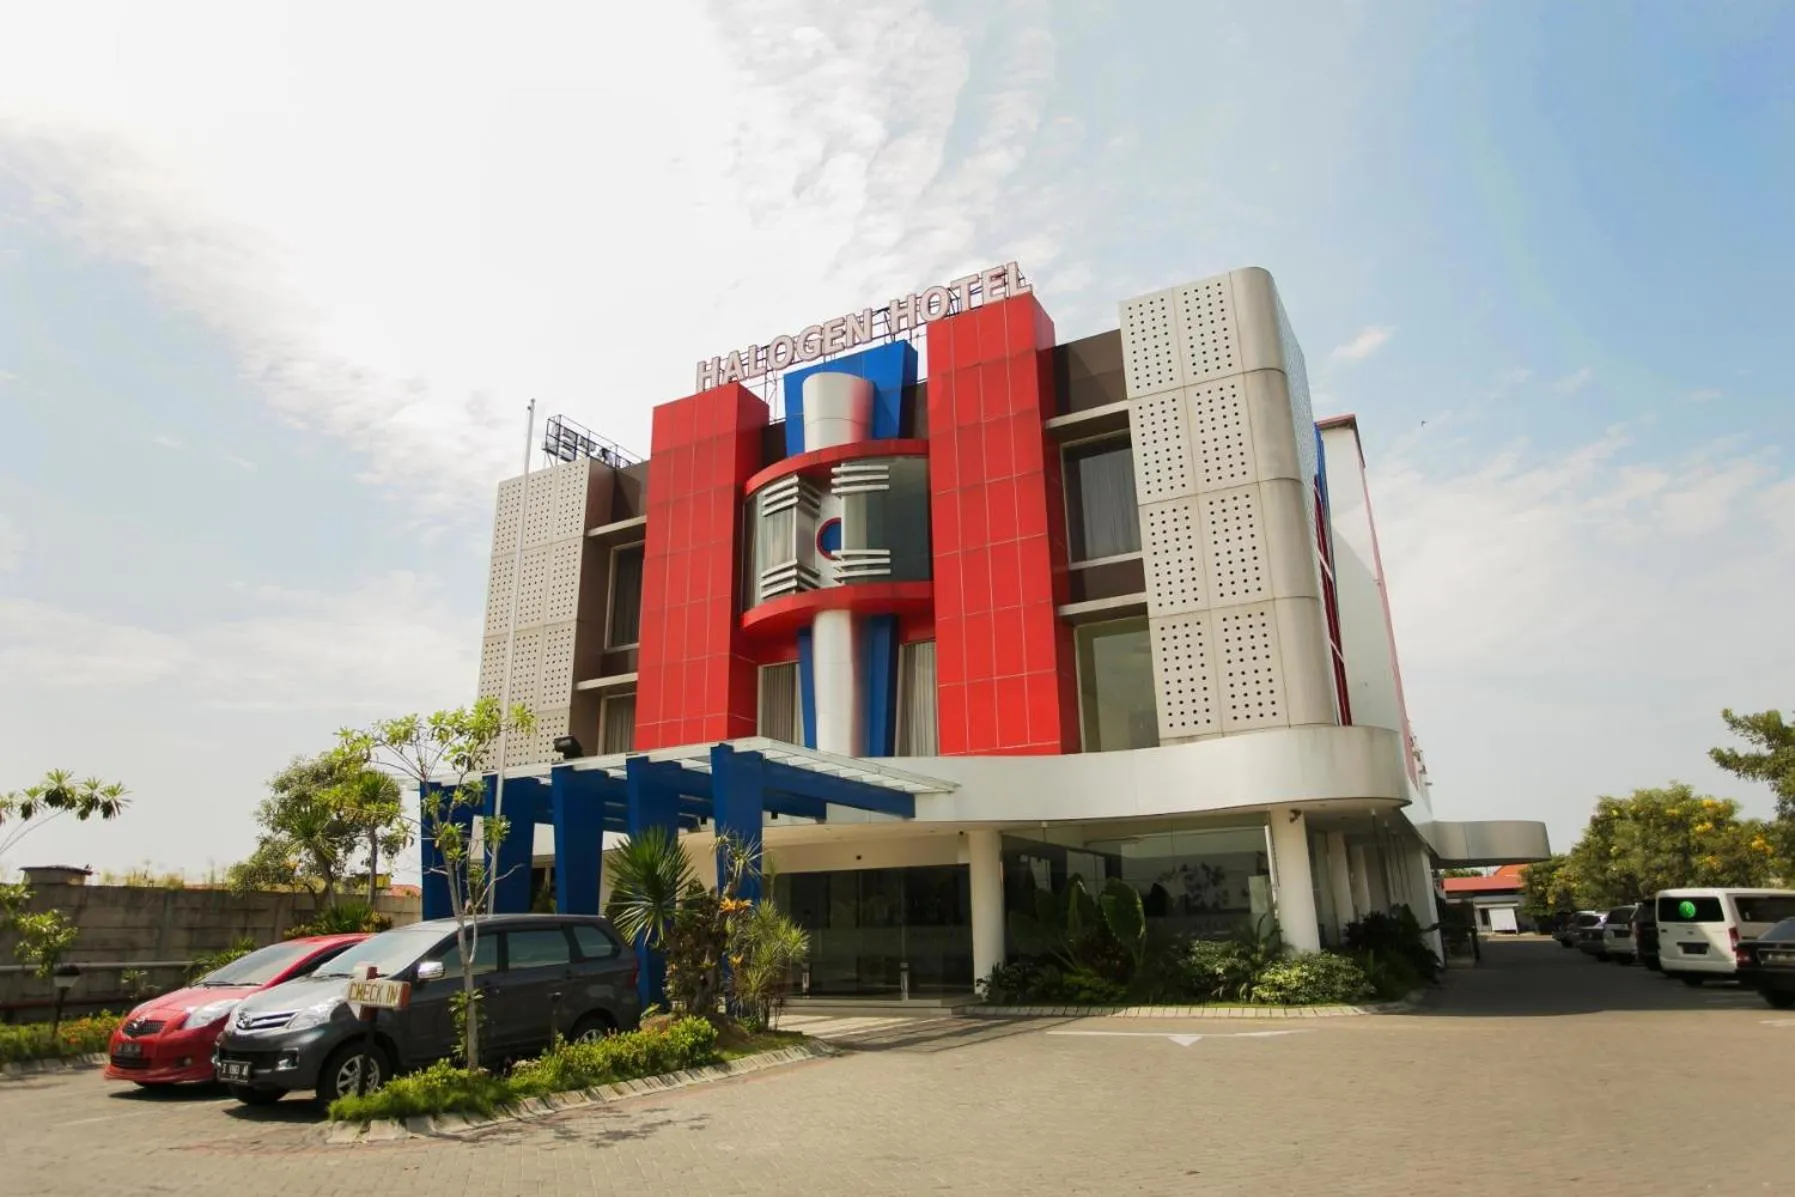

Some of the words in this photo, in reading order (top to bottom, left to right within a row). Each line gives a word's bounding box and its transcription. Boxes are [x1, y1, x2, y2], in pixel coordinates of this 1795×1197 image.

[696, 308, 873, 392] HALOGEN
[888, 261, 1033, 334] HOTEL
[349, 982, 383, 1002] CHECK
[386, 984, 399, 1003] IN
